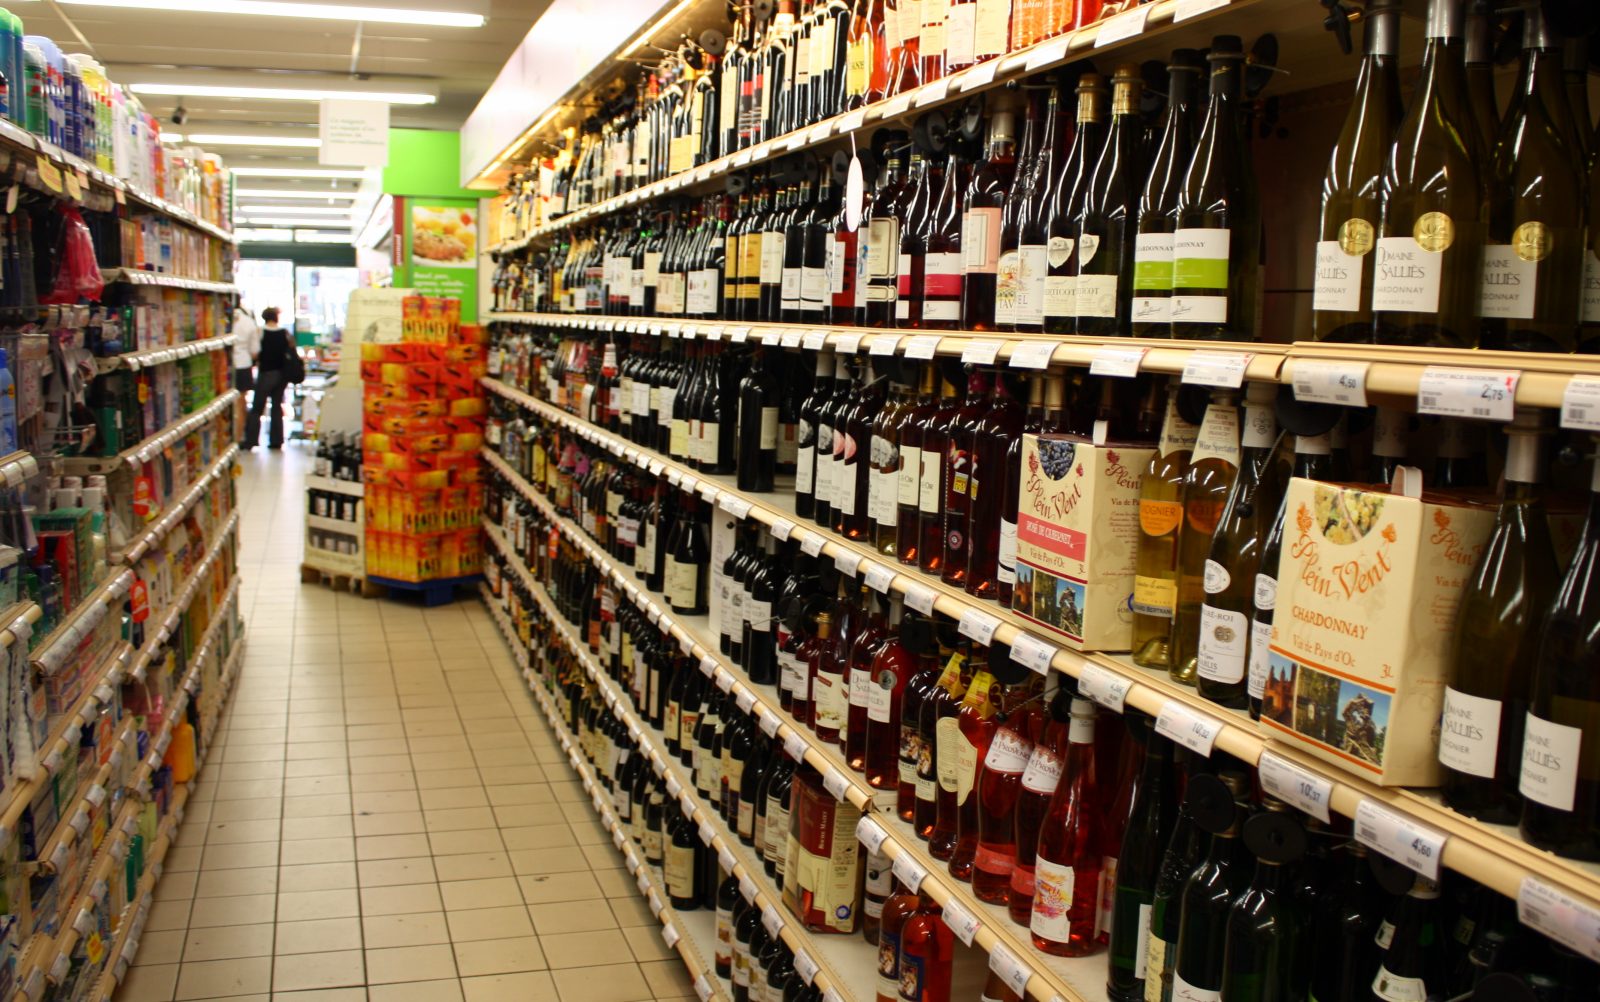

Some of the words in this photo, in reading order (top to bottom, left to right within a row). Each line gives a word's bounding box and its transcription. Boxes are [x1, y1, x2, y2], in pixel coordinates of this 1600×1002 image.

[1026, 473, 1051, 520] Plein
[1050, 483, 1082, 520] Vent
[1291, 533, 1338, 598] Plein
[1332, 549, 1392, 600] Vent
[1292, 605, 1369, 640] CHARDONNAY
[1313, 641, 1333, 662] Pays
